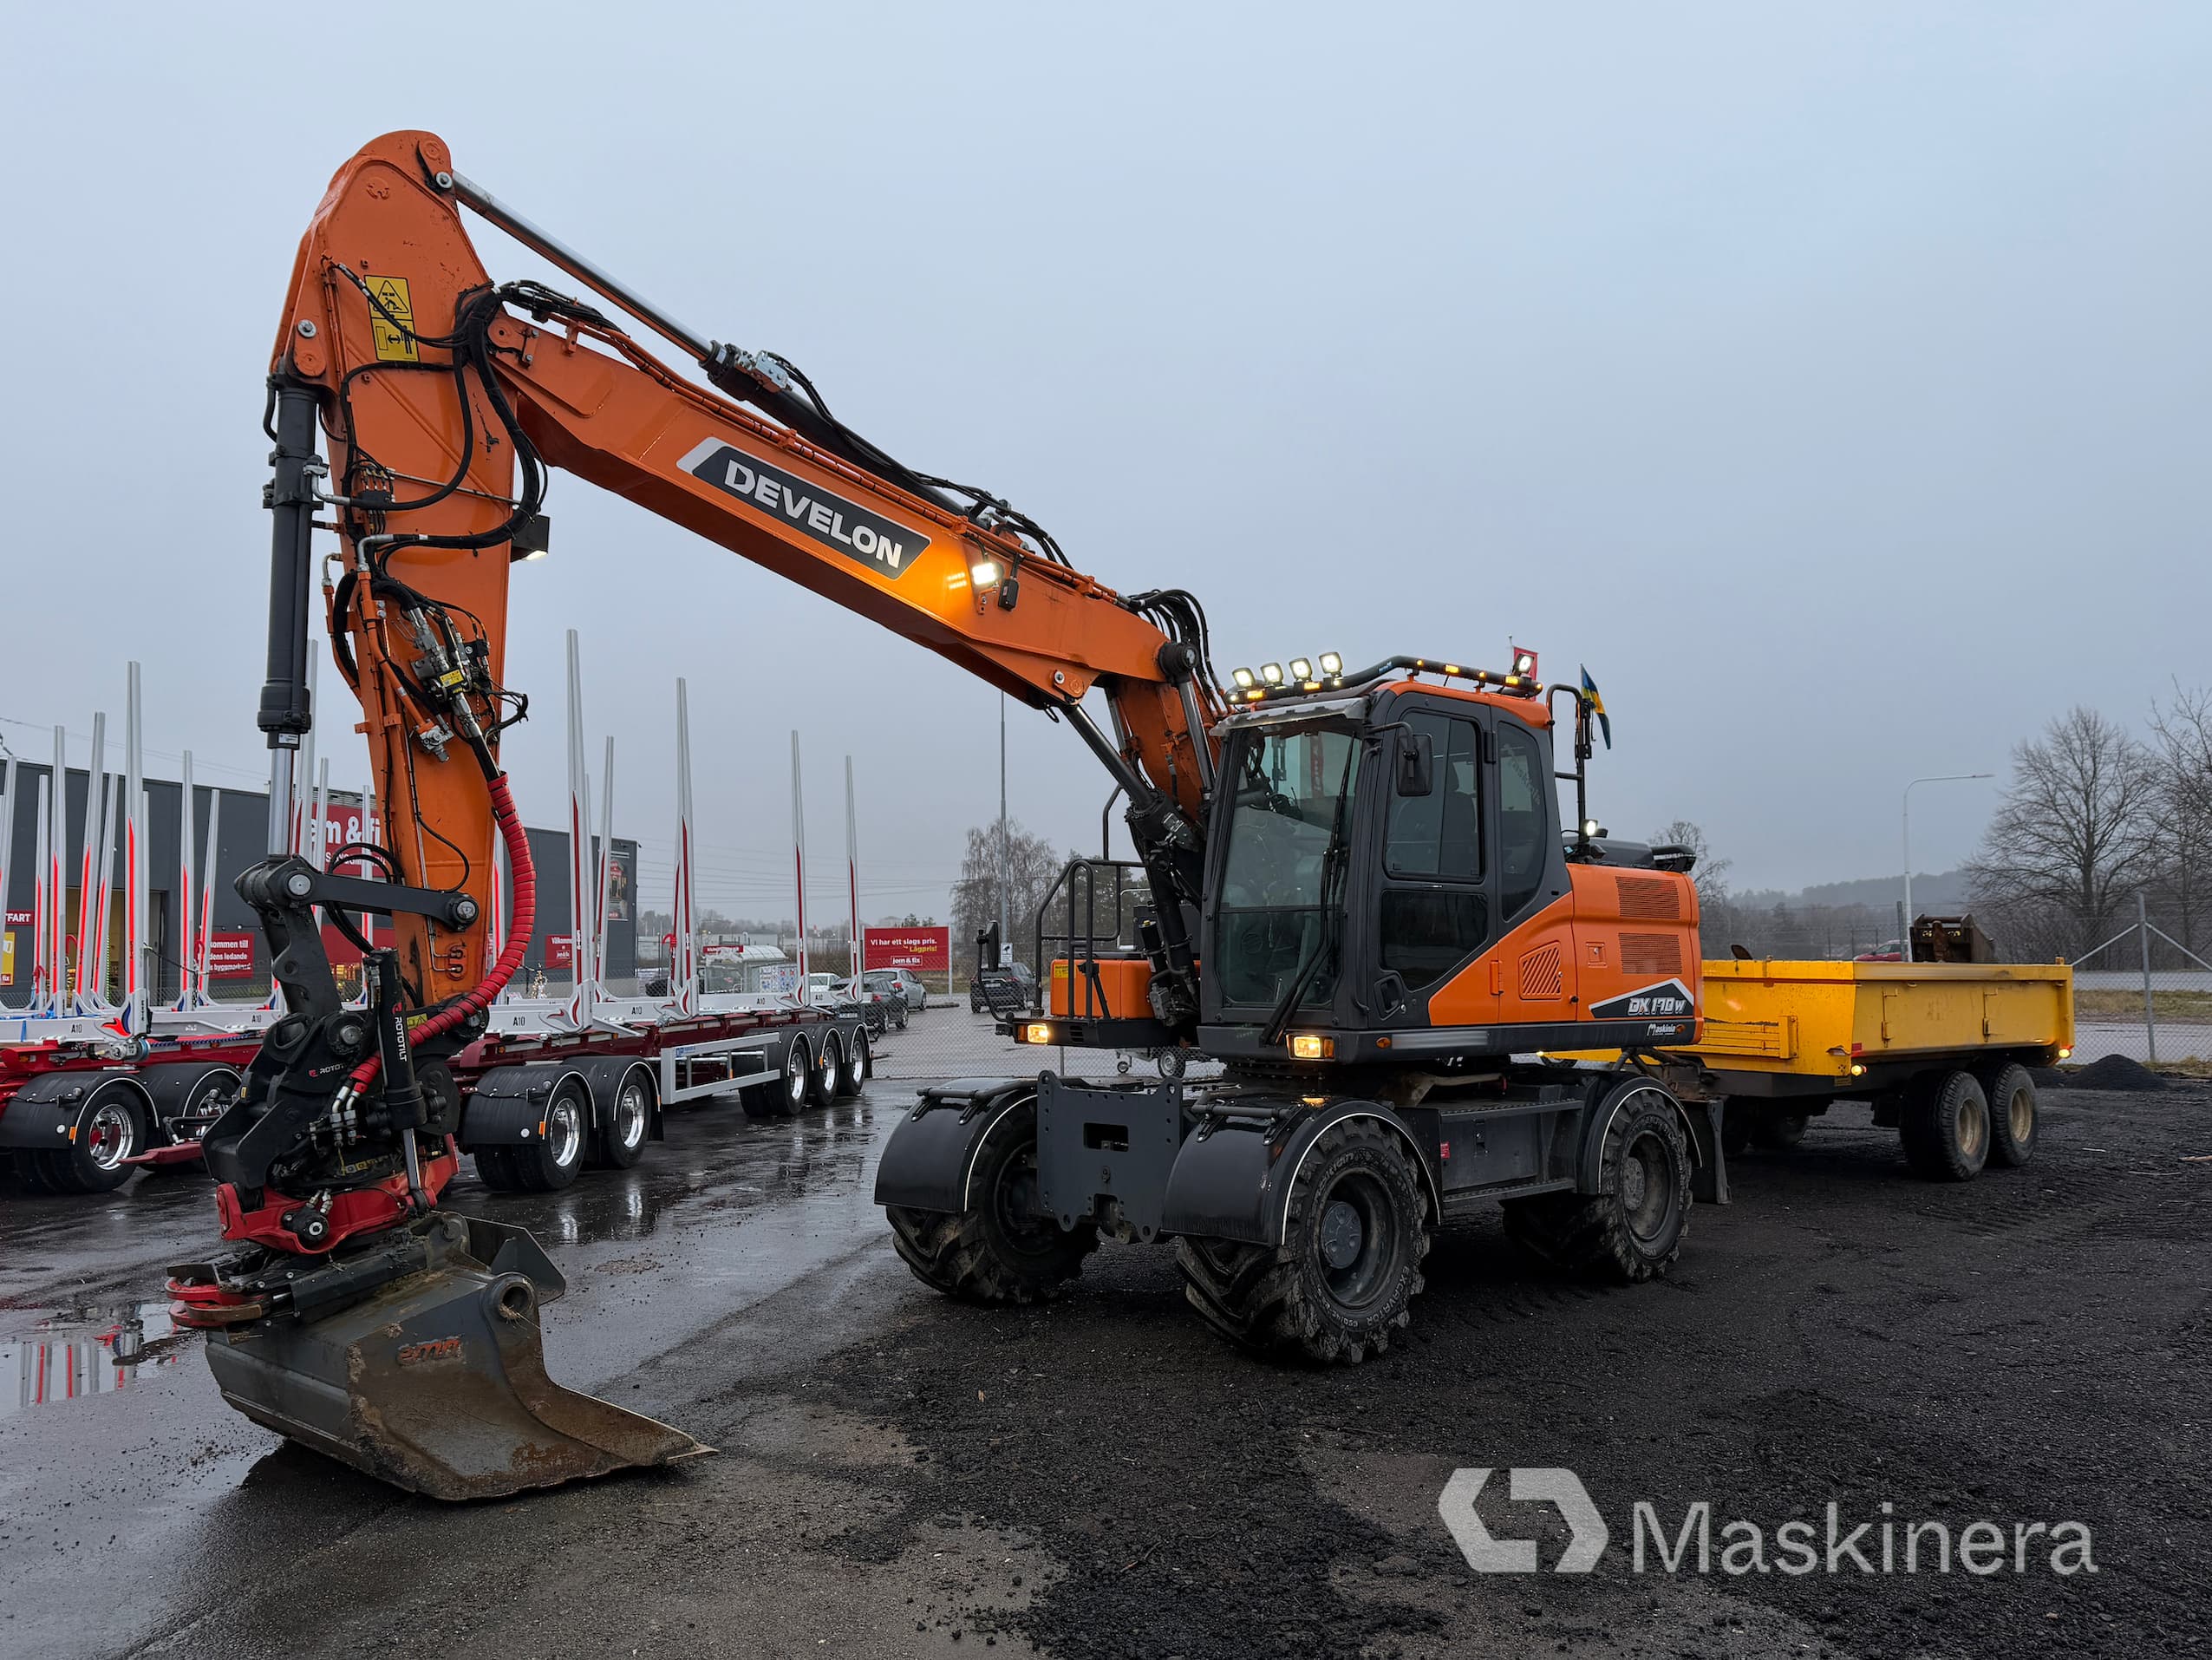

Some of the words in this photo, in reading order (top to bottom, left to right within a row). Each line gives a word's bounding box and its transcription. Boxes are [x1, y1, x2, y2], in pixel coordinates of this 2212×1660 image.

[724, 460, 903, 568] DEVELON
[238, 939, 249, 948] till
[631, 1006, 643, 1015] A10
[251, 1014, 262, 1023] A10
[512, 1017, 525, 1027] A10
[71, 1023, 82, 1034] A10
[395, 1016, 408, 1062] ROTOTILT
